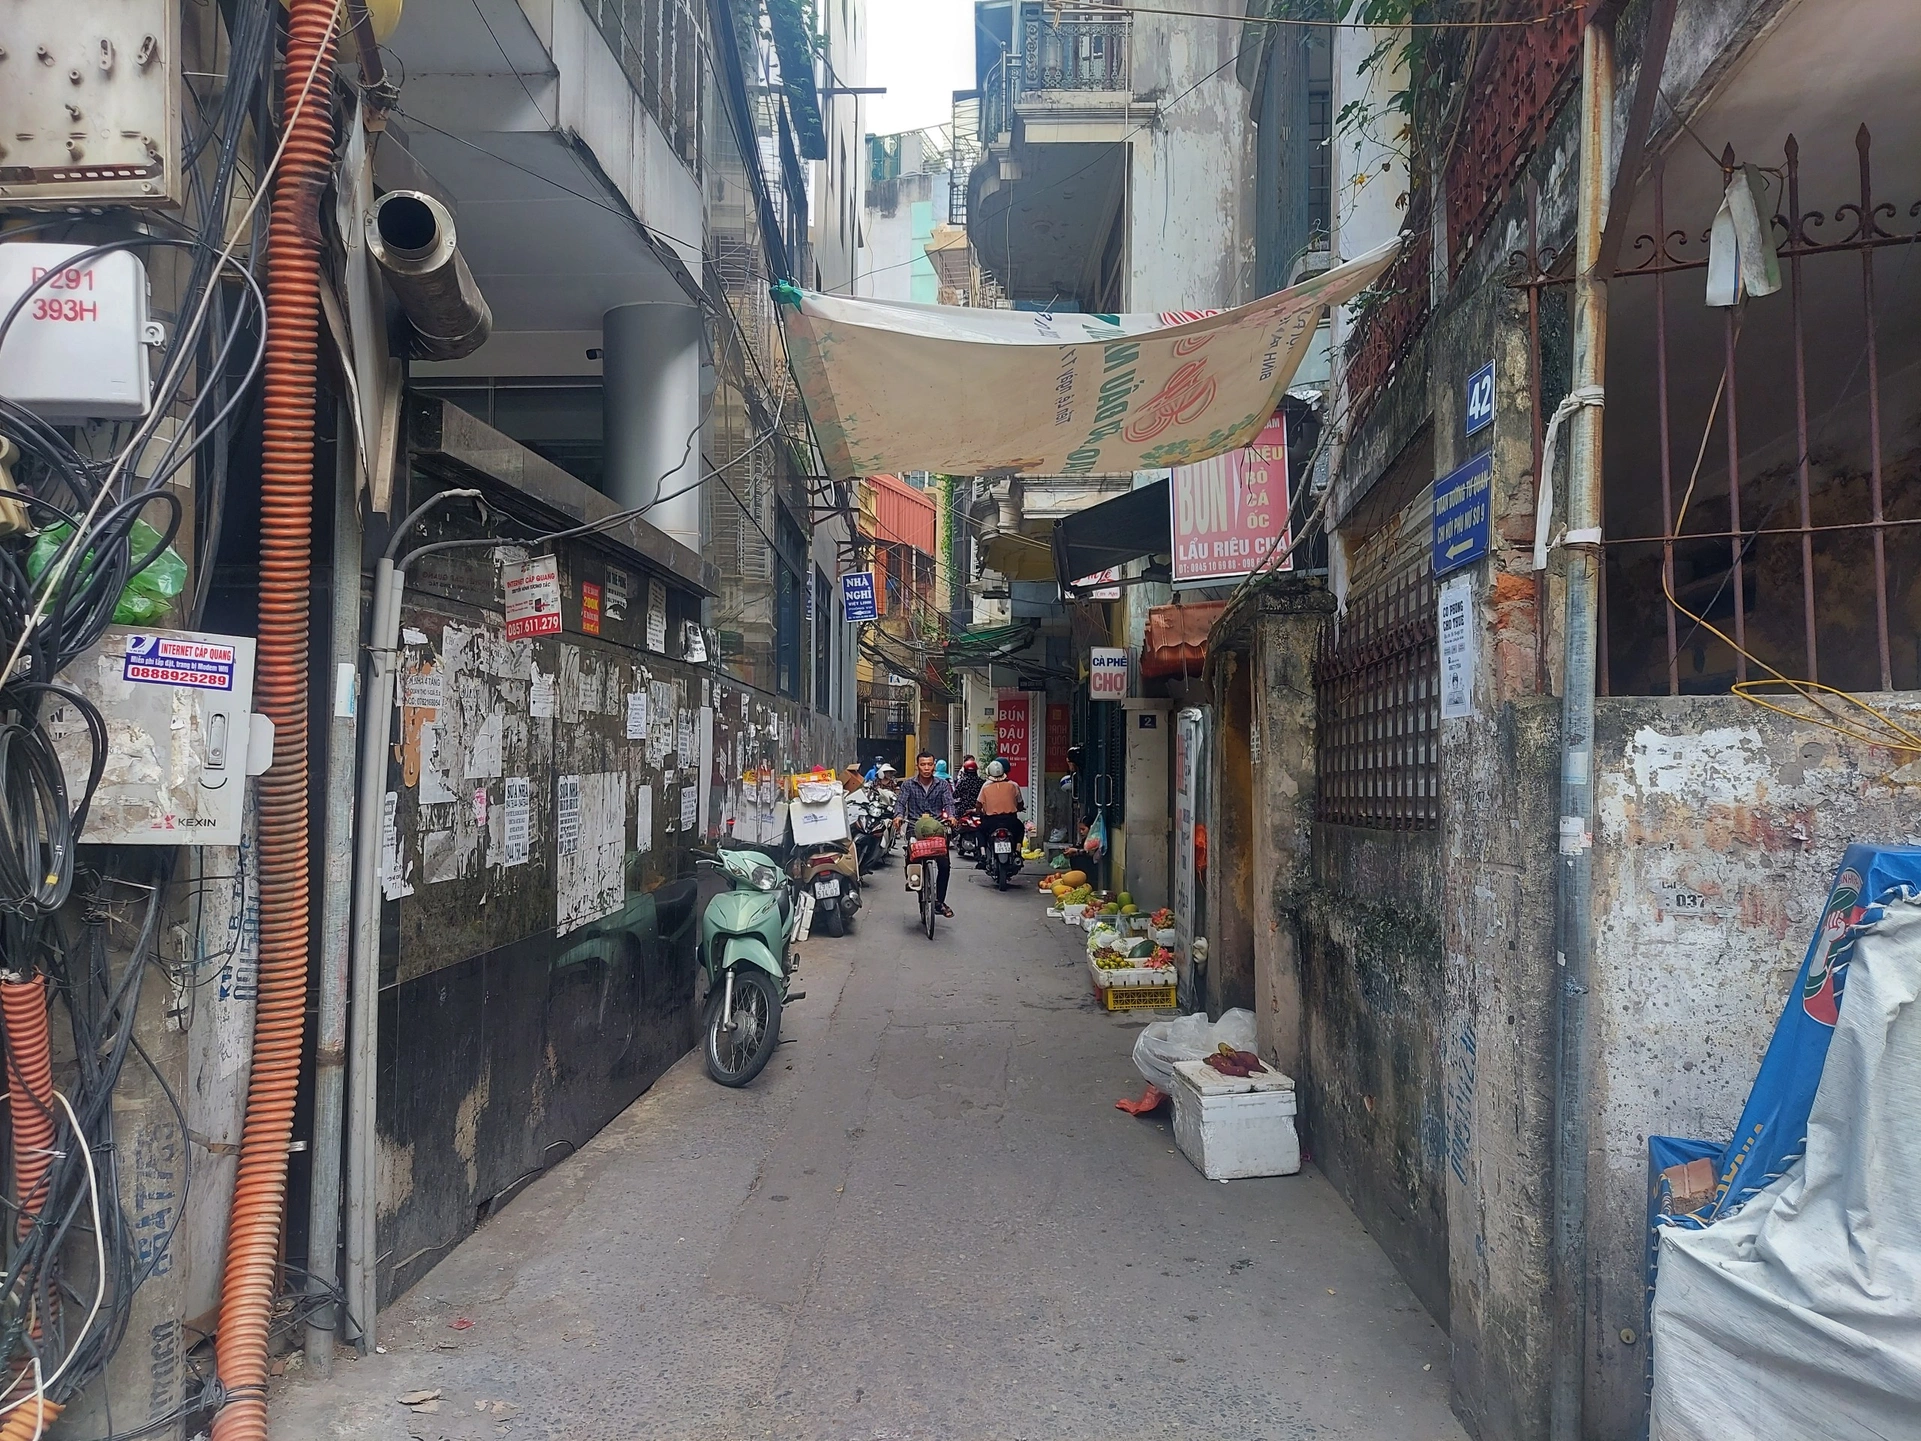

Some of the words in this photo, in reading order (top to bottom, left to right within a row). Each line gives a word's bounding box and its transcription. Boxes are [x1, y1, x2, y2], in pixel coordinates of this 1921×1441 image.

[32, 298, 97, 322] 393H
[1469, 374, 1492, 421] 42
[1263, 417, 1280, 430] AM
[1245, 466, 1268, 486] BÒ
[1246, 488, 1270, 508] CÁ
[1246, 509, 1270, 529] ỐC
[1179, 537, 1209, 561] LẨU
[1213, 536, 1250, 558] RIÊU
[846, 574, 870, 588] NHÀ
[845, 587, 872, 601] NGHỈ
[161, 642, 193, 657] INTERNET
[194, 645, 208, 659] CÁP
[209, 647, 232, 661] QUANG
[1092, 655, 1105, 667] CÀ
[1106, 655, 1127, 667] PHÊ
[131, 666, 227, 686] 0888925289
[1092, 671, 1125, 696] CHỢ
[999, 705, 1025, 722] BÚN
[1144, 717, 1152, 726] 2
[999, 724, 1025, 742] ĐẬU
[1000, 743, 1021, 755] MƠ
[177, 818, 217, 827] KEXIN
